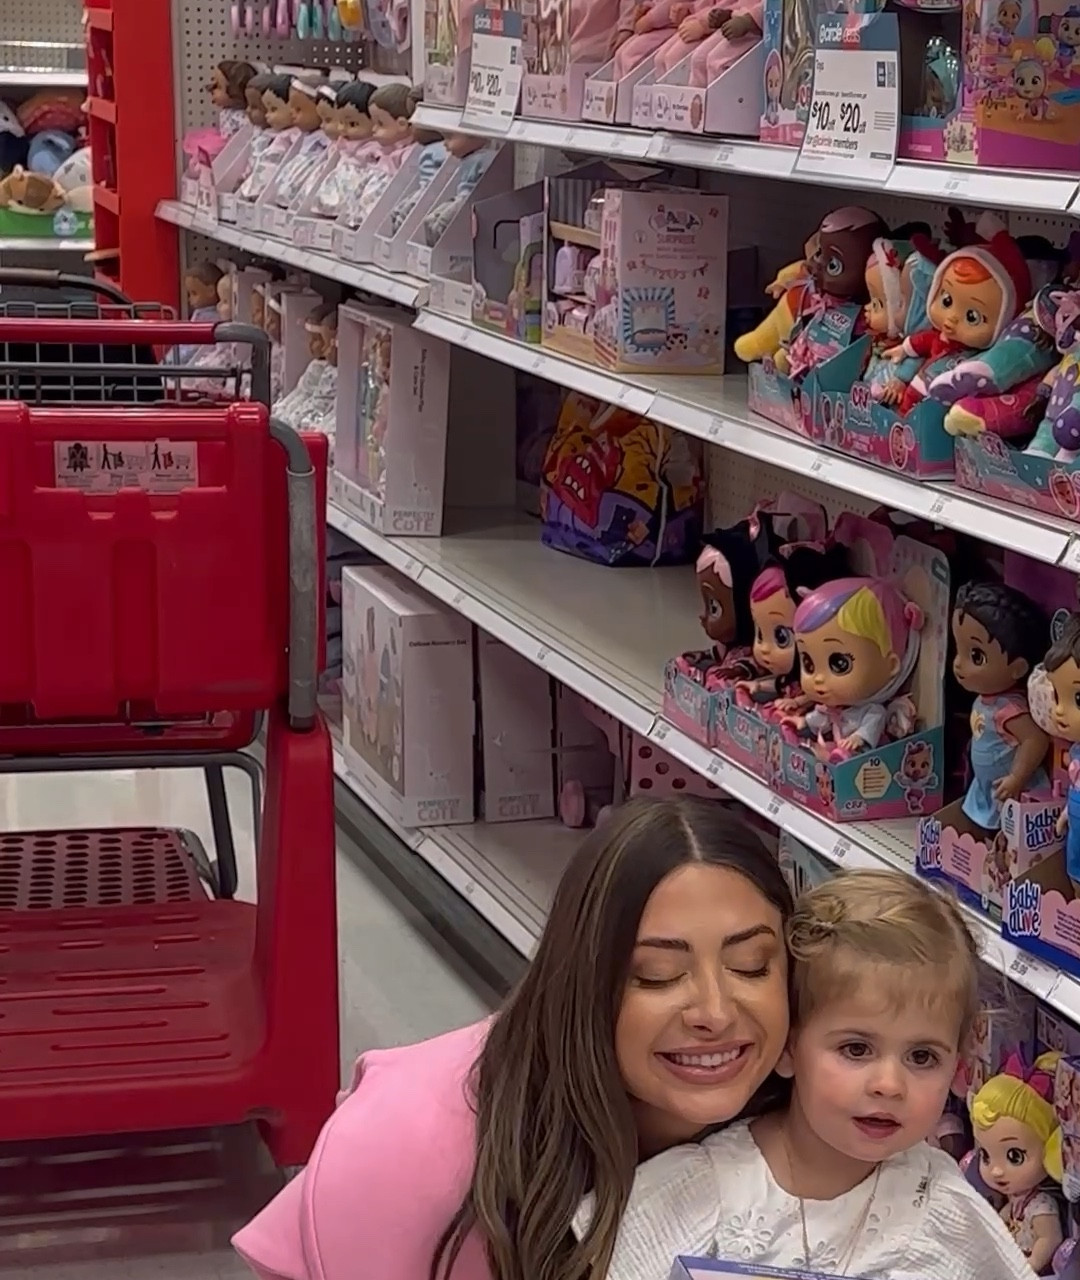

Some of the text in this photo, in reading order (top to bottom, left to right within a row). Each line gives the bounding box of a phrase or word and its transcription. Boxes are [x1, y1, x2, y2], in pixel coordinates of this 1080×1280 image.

[811, 100, 831, 131] $10
[839, 102, 861, 134] $20
[868, 758, 881, 768] 10
[1009, 880, 1042, 910] baby
[1009, 908, 1041, 936] alive
